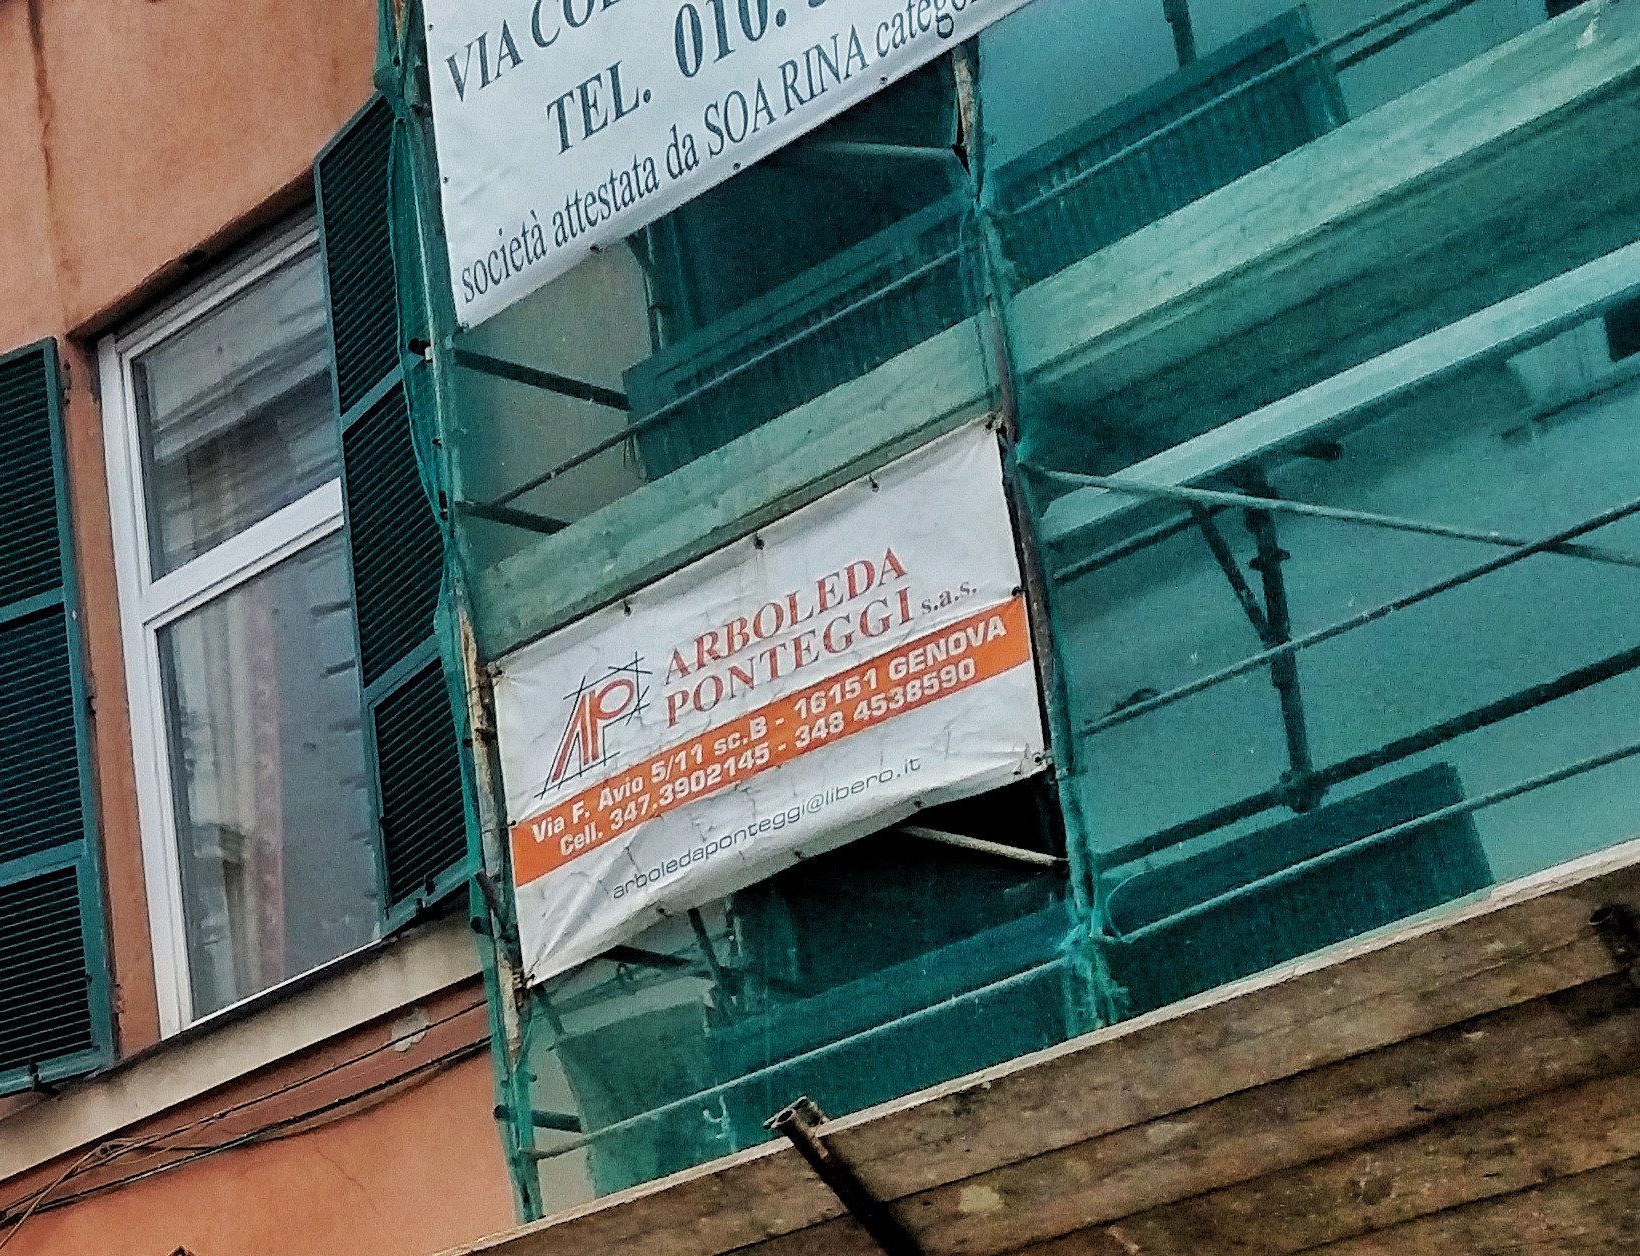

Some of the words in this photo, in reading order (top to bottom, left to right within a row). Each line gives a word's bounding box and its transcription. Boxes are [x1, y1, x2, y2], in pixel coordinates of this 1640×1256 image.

[445, 19, 523, 102] VIA
[531, 0, 621, 48] CO
[546, 60, 652, 155] TEL.
[460, 209, 547, 303] società
[552, 153, 660, 248] attestata
[665, 123, 701, 178] da
[704, 77, 777, 157] SOA
[778, 24, 870, 115] RINA
[665, 548, 908, 686] ARBOLEDA
[665, 587, 915, 728] PONTEGGI
[921, 581, 978, 615] s.a.s.
[532, 815, 566, 844] Via
[572, 800, 591, 824] F.
[598, 776, 644, 811] Avio
[651, 744, 703, 784] 5/11
[794, 668, 877, 720] 16151
[888, 615, 1007, 681] GENOVA
[560, 825, 603, 856] Cell.
[610, 741, 771, 832] 347.3902145
[795, 711, 844, 749] 348
[853, 657, 976, 722] 4538590
[613, 757, 921, 899] arboledaponteggi@libero.it
